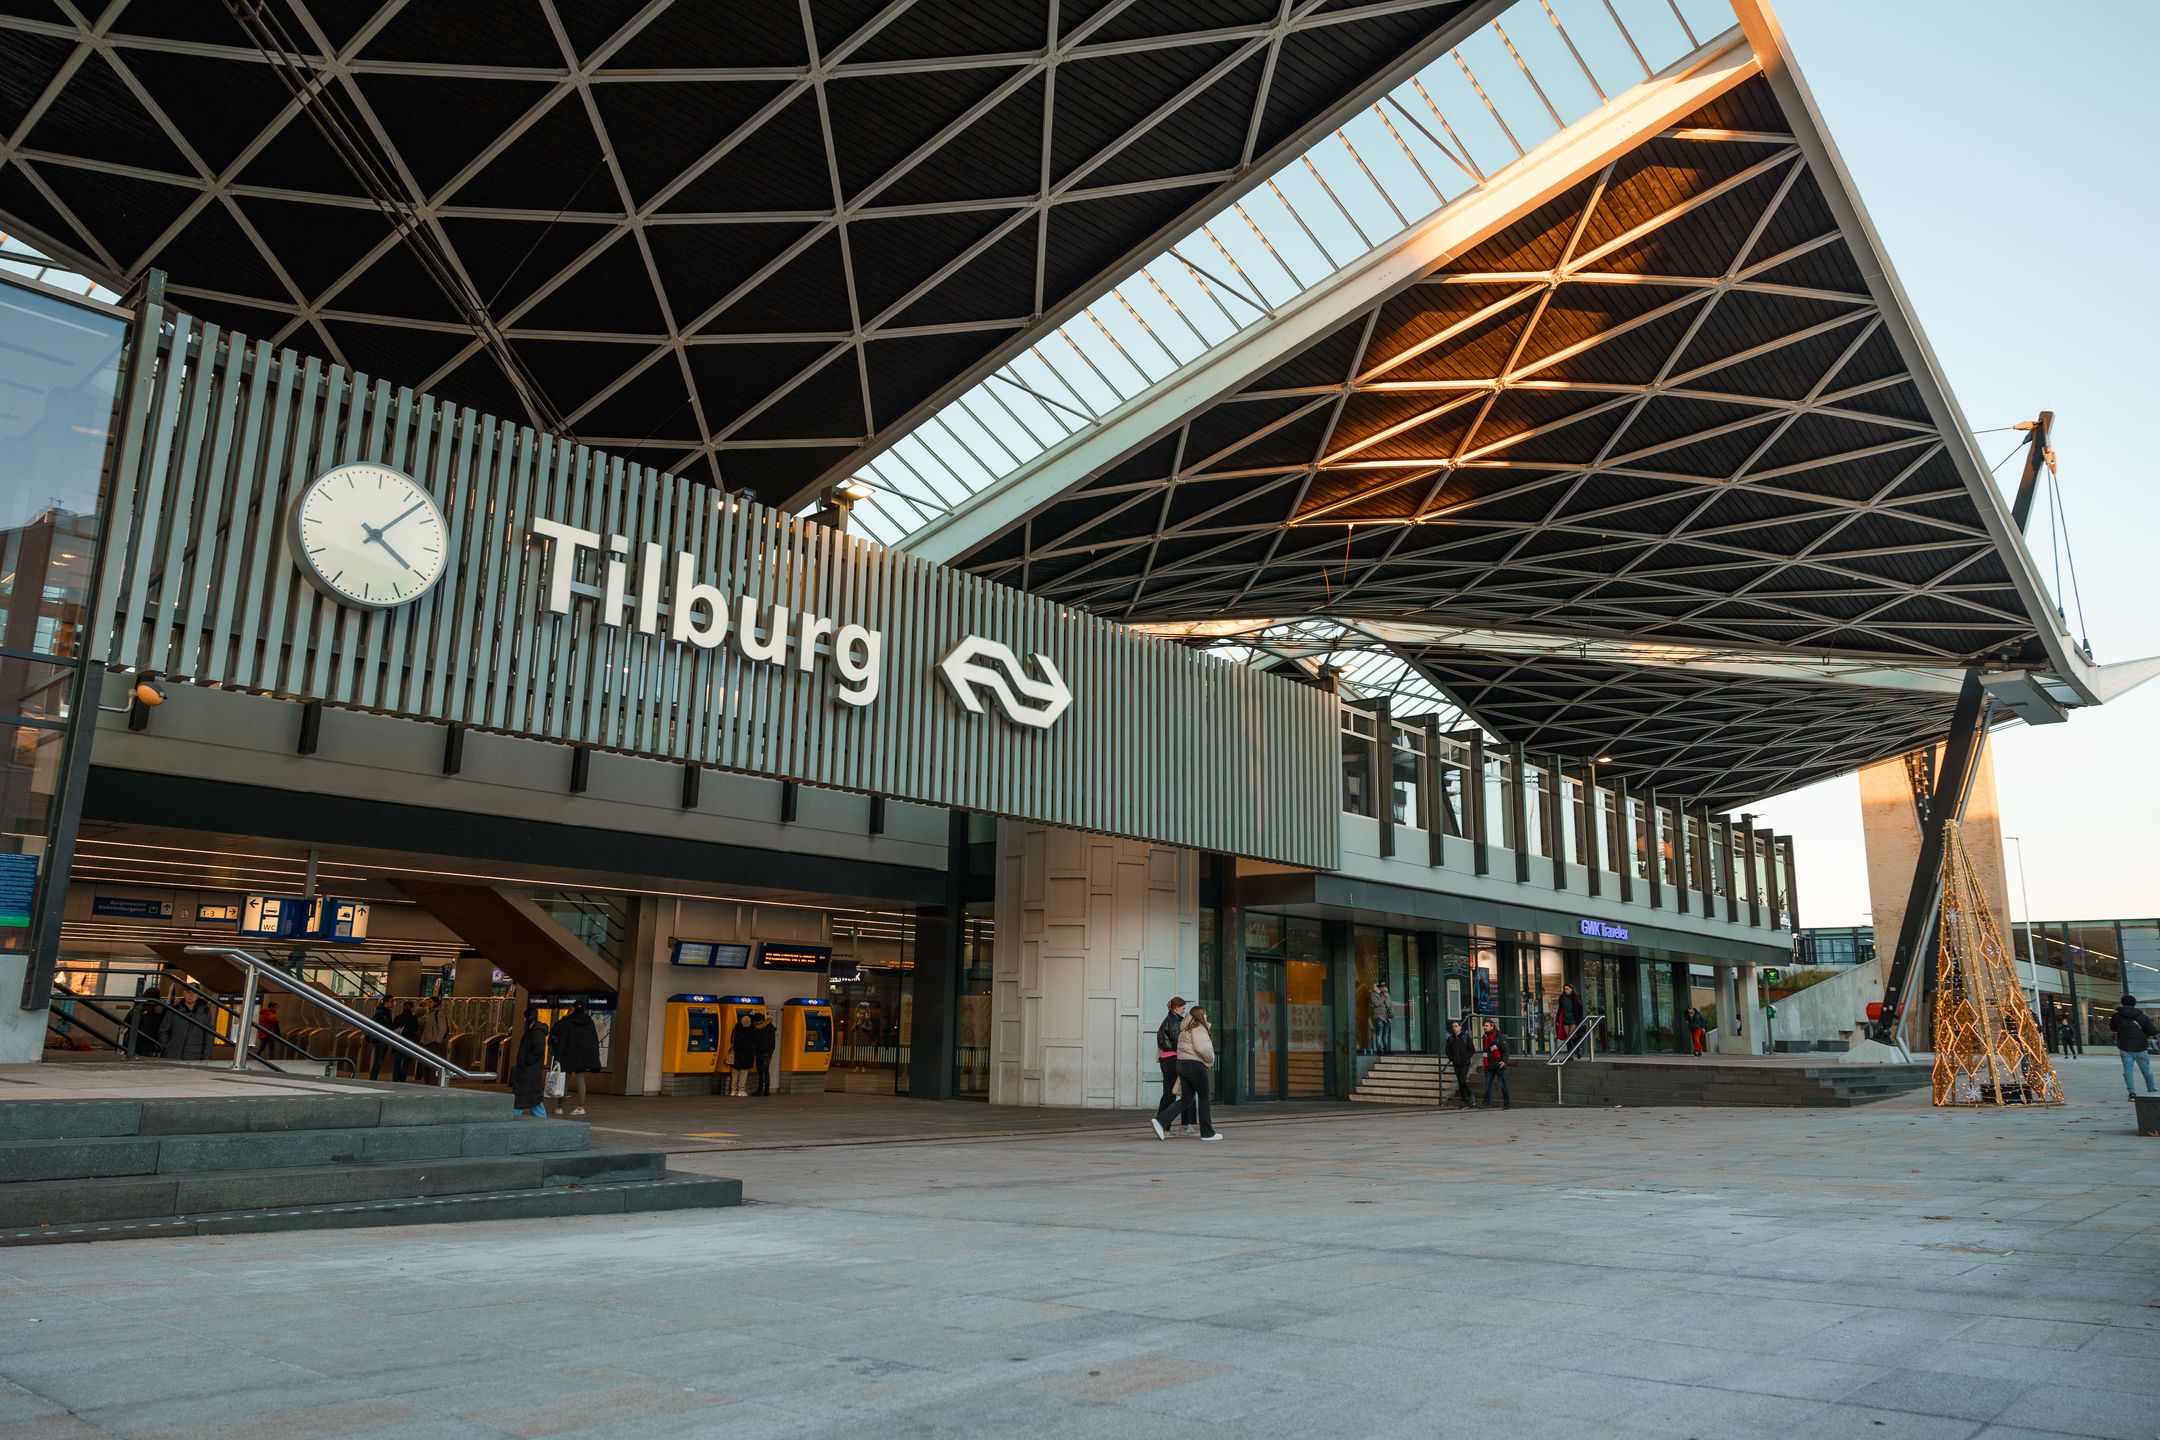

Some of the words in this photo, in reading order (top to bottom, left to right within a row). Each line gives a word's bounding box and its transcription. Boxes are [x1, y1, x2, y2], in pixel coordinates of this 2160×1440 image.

[532, 516, 882, 707] Tilburg
[1581, 919, 1601, 936] GWK
[1601, 922, 1629, 940] Travelex
